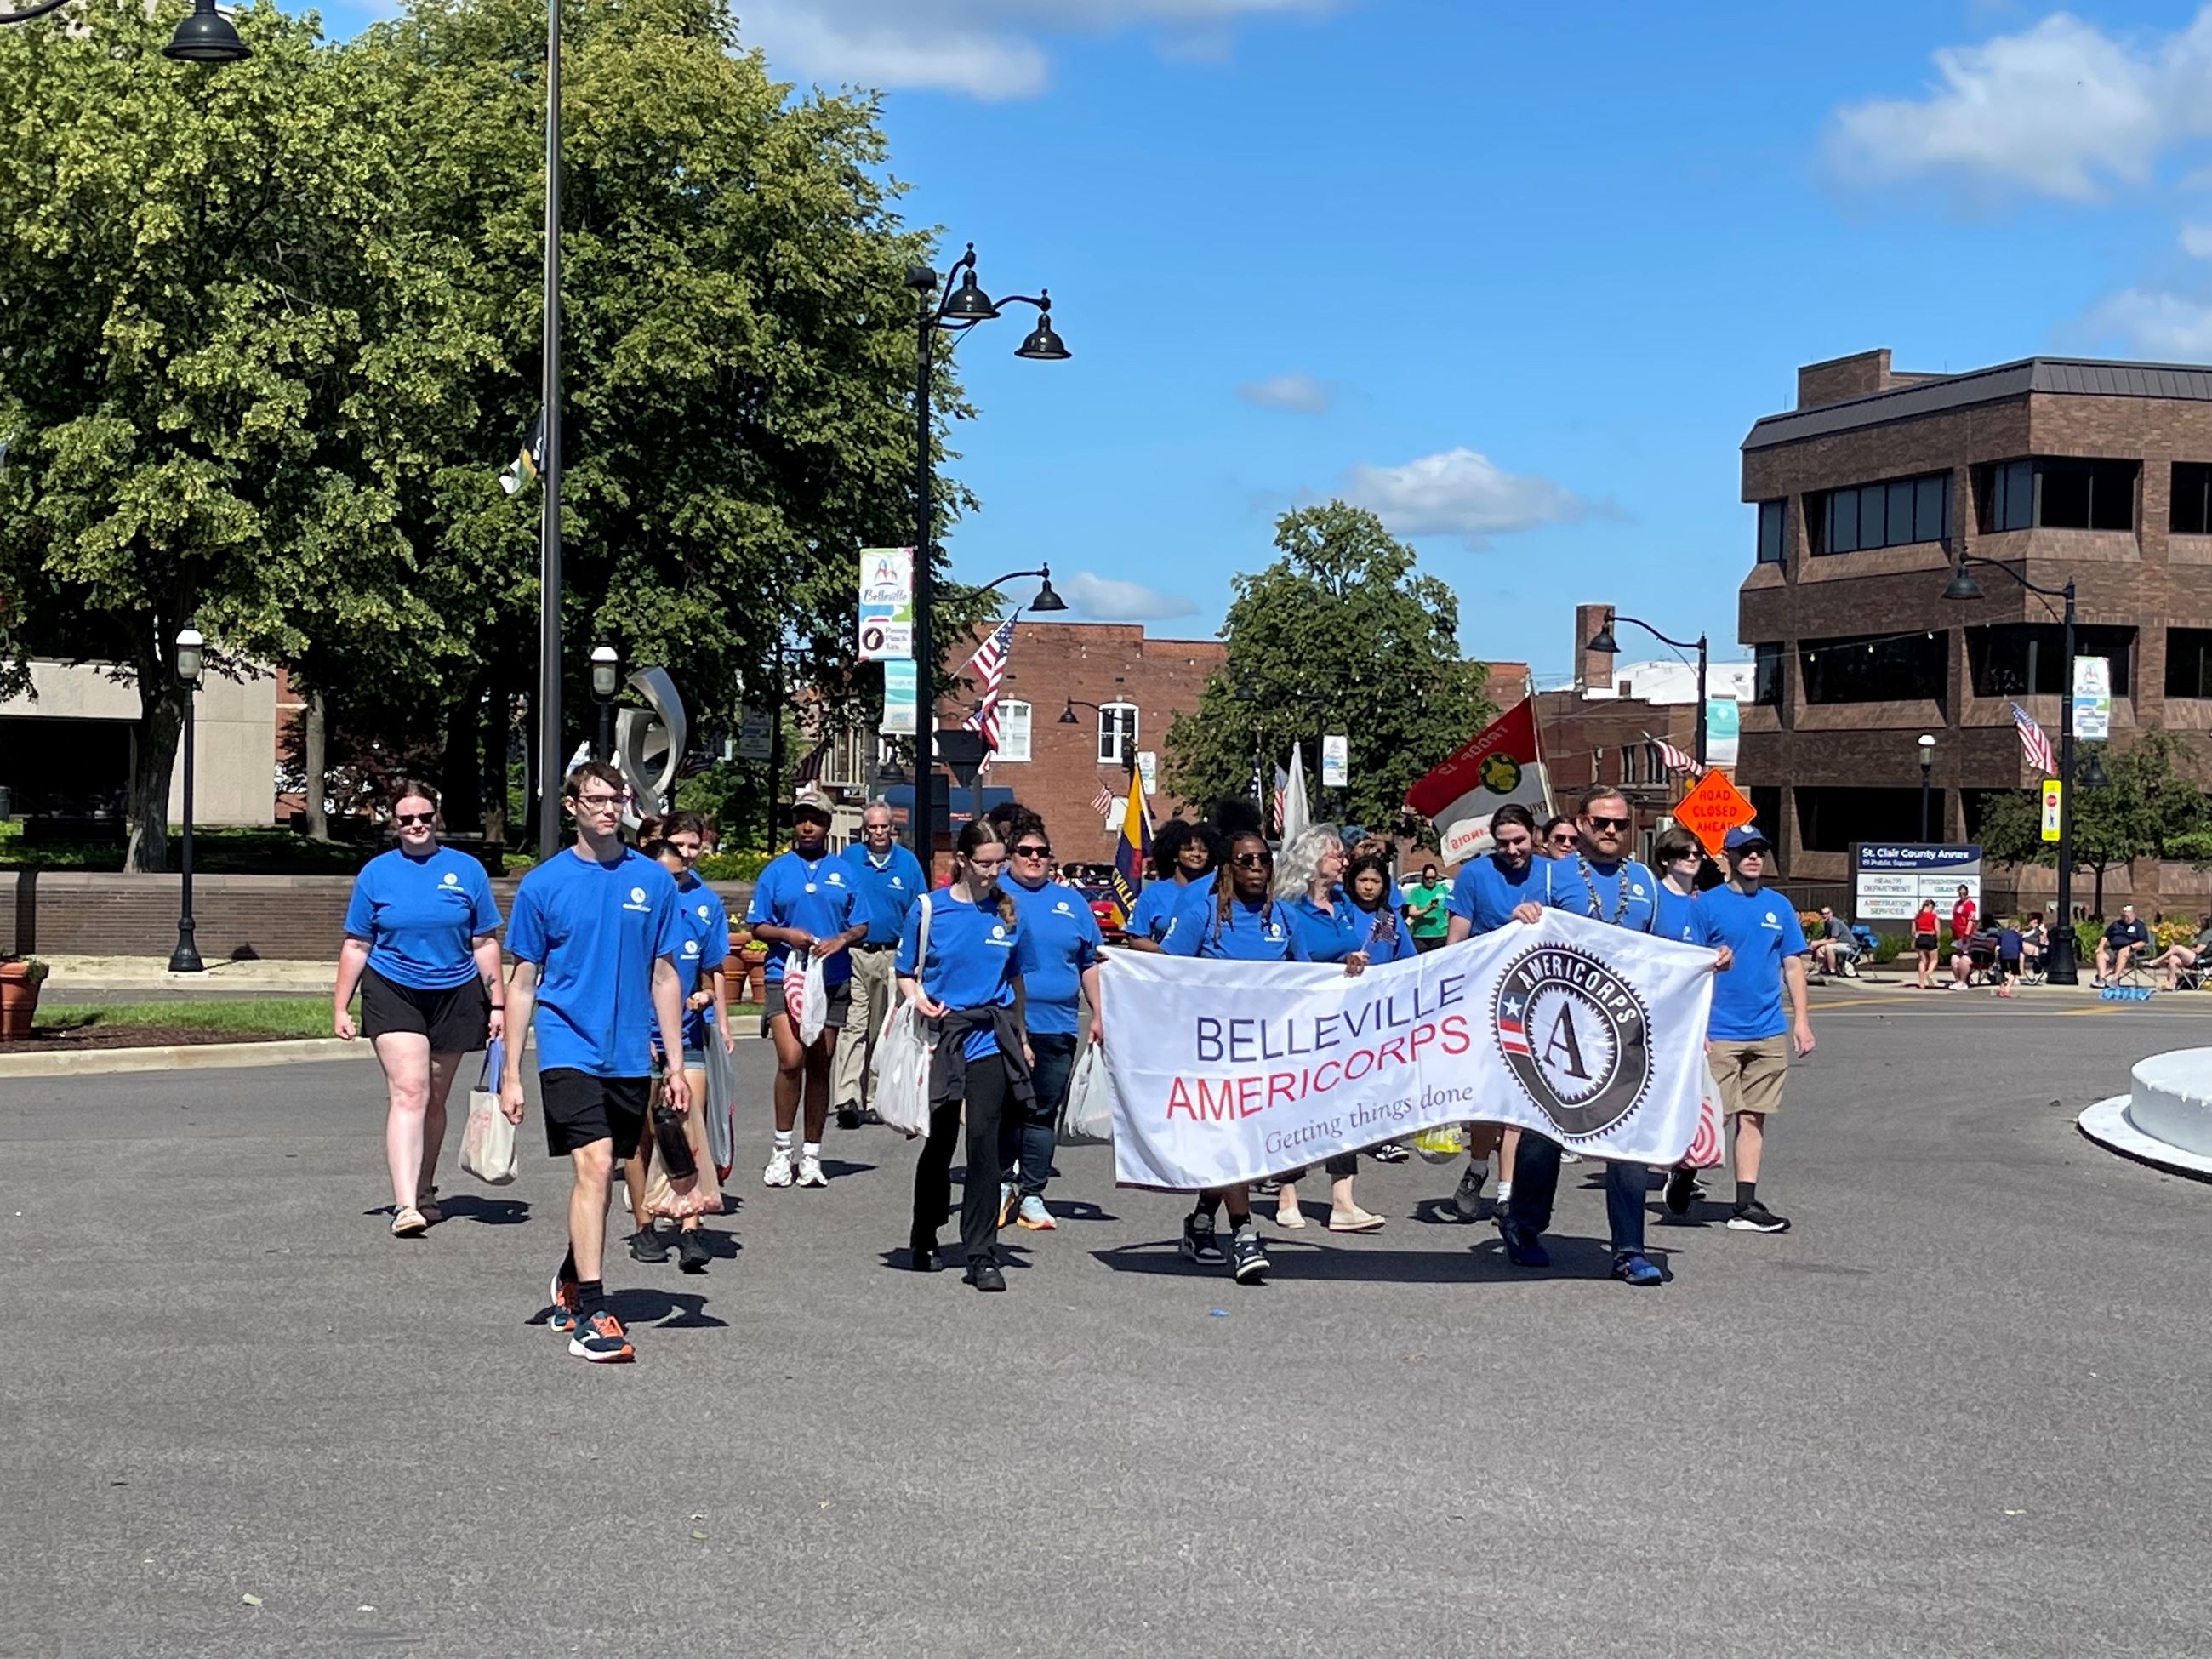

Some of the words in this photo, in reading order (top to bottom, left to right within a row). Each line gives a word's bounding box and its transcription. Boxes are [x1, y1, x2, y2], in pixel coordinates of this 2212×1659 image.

[1692, 805, 1737, 817] CLOSED
[1699, 790, 1730, 801] ROAD
[1862, 847, 1875, 858] St.
[1877, 847, 1899, 858] Clair
[1901, 849, 1936, 860] County
[1938, 849, 1969, 858] Annex
[1196, 974, 1466, 1063] BELLEVILLE
[1517, 955, 1637, 1024] AMERICORPS
[1166, 1014, 1471, 1121] AMERICORPS
[1542, 1000, 1593, 1080] A
[1266, 1119, 1343, 1154] Getting
[1349, 1097, 1412, 1129] things
[1420, 1083, 1474, 1110] done
